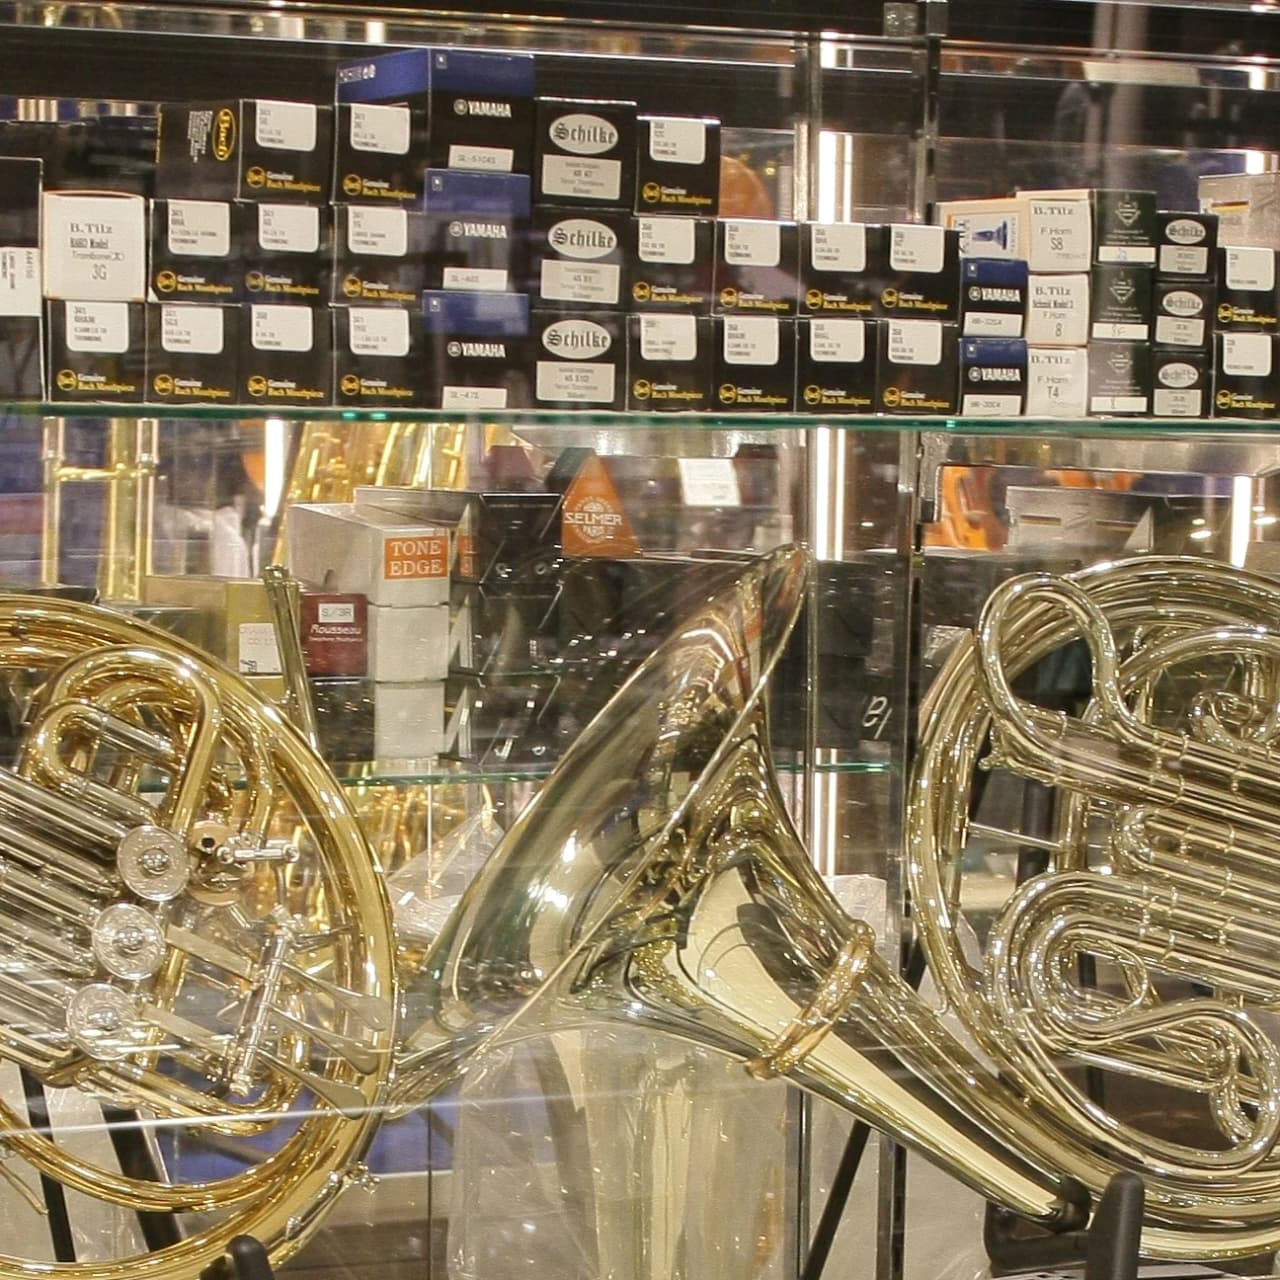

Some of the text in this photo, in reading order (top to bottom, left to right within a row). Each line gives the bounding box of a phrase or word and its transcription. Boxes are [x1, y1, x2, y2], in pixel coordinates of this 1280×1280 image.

[468, 100, 512, 117] YAMAHA
[554, 122, 615, 146] Schilke
[1033, 206, 1074, 216] B.Tilz
[70, 223, 112, 234] B.Tilz
[463, 222, 508, 238] YAMAHA
[553, 227, 614, 250] Schilke
[1035, 286, 1071, 296] B.Tilz
[547, 329, 608, 350] Schilke
[461, 342, 506, 358] YAMAHA
[1032, 356, 1072, 364] B.Tilz
[563, 512, 622, 526] SELMER
[392, 540, 441, 556] TONE
[389, 560, 444, 576] EDGE
[310, 624, 362, 635] Rousseau
